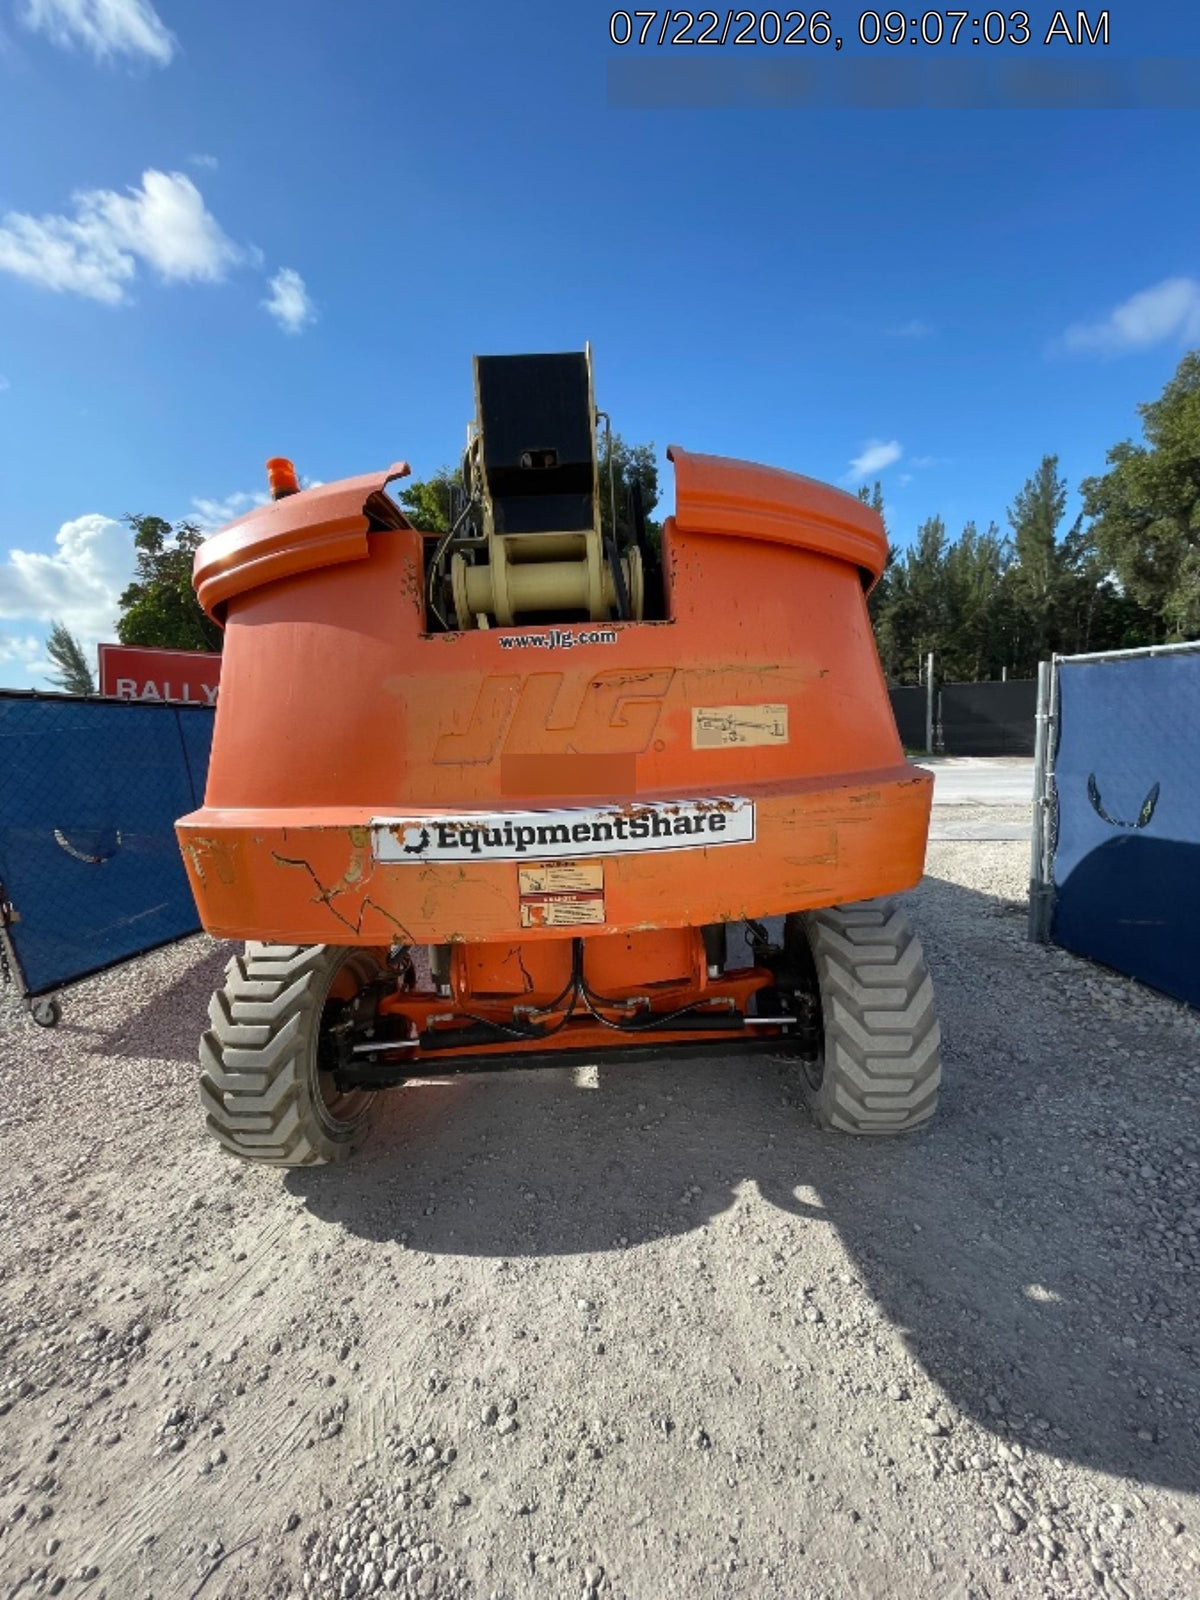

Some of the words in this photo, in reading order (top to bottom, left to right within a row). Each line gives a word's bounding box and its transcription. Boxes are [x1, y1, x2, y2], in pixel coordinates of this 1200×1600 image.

[499, 629, 617, 650] www.jlg.com
[116, 678, 219, 705] RALLY
[432, 666, 676, 765] JLG
[437, 809, 726, 852] EquipmentShare
